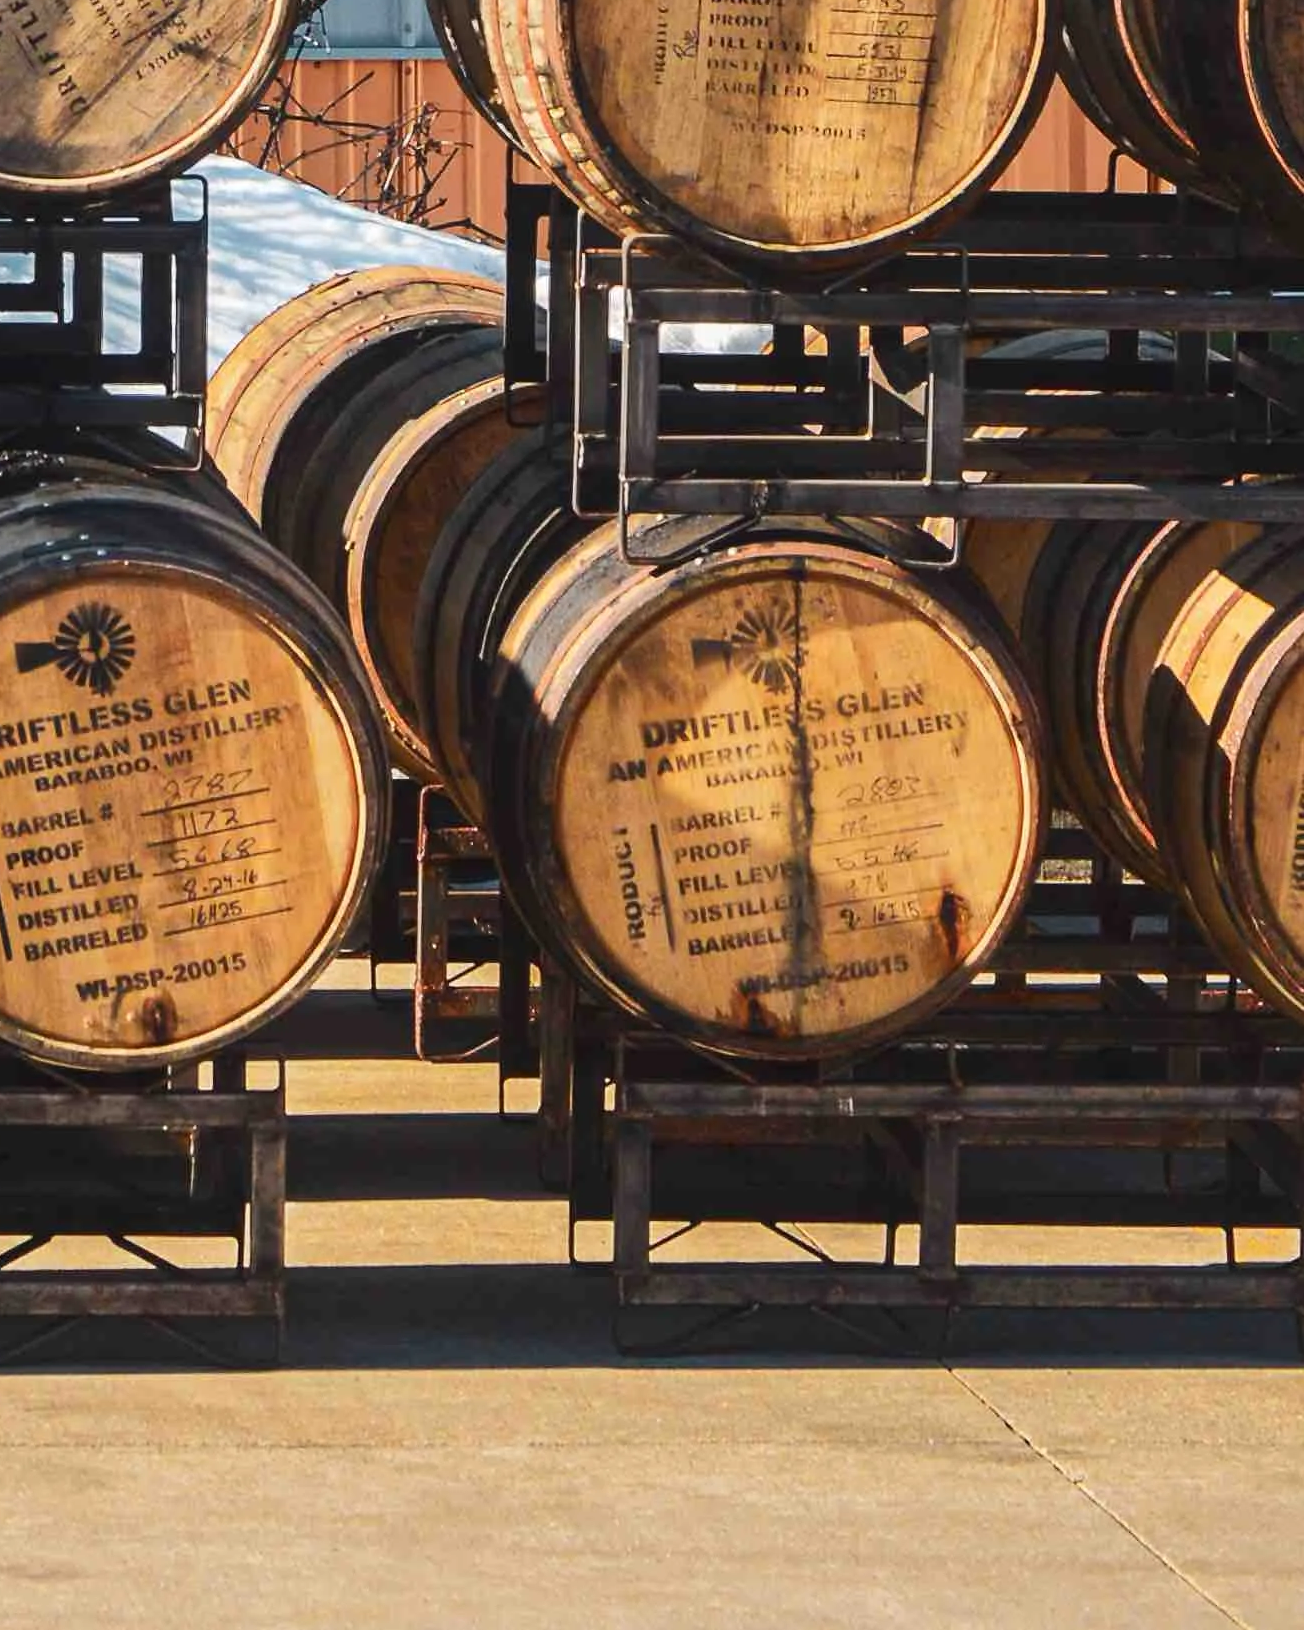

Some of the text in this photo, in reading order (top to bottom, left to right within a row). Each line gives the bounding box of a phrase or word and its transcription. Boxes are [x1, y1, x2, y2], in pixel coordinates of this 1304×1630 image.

[709, 13, 773, 27] PROOF
[164, 679, 251, 716] GLEN
[139, 703, 301, 750] DISTILLERY
[641, 684, 925, 749] DRIFTLESS GLEN
[163, 749, 193, 767] WI
[607, 711, 970, 784] AN AMERICAN DISTILLERY
[836, 751, 864, 769] WI
[1, 803, 113, 839] BARREL #
[670, 807, 763, 835] BARREL
[5, 841, 85, 870] PROOF
[674, 838, 753, 864] PROOF
[11, 862, 143, 900] FILL LEVEL
[678, 859, 803, 895] FILL LEVE
[17, 893, 140, 932] DISTILLED
[24, 923, 148, 962] BARRELED
[687, 925, 798, 957] BARRELE
[76, 952, 247, 1003] WI-DSP-20015
